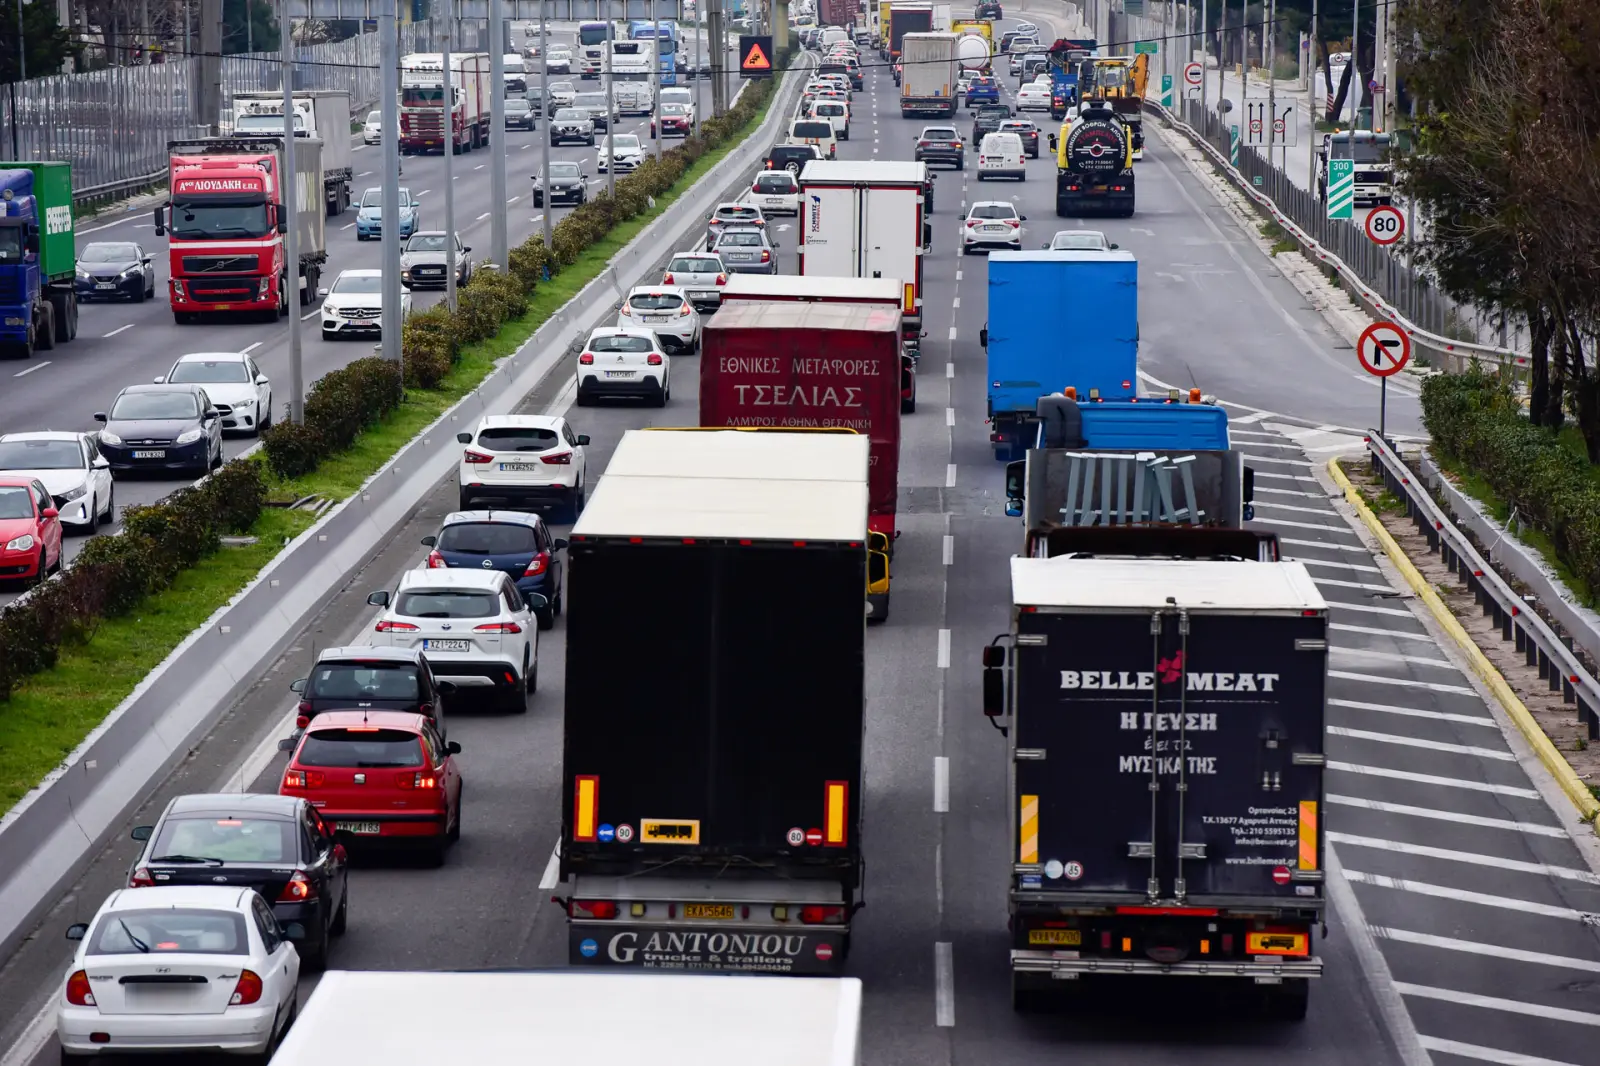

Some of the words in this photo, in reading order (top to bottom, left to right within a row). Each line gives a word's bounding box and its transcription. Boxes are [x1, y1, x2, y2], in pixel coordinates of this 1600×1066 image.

[1333, 162, 1349, 170] 300
[194, 180, 242, 191] ΛΙΟΥΔΑΚΗ
[1374, 217, 1396, 232] 80
[720, 357, 781, 374] ΕΘΝΙΚΕΣ
[792, 358, 880, 376] ΜΕΤΑΦΟΡΕΣ
[733, 385, 862, 407] ΤΣΕΛΙΑΣ
[726, 416, 777, 426] ΑΛΜΥΡΟΣ
[781, 417, 818, 427] ΑΘΗΝΑ
[822, 418, 872, 429] ΘΕΣ/ΝΙΚΗ
[1060, 670, 1155, 690] BELLE
[1186, 672, 1280, 692] MEAT
[1120, 711, 1138, 730] Η
[1143, 711, 1218, 731] ΓΕΥΣΗ
[1186, 756, 1217, 774] ΤΗΣ
[1287, 807, 1297, 815] 25
[619, 828, 630, 837] 90
[791, 832, 801, 841] 80
[1249, 827, 1263, 835] 210
[1264, 827, 1296, 835] 5595135
[1225, 856, 1297, 867] www.bellemeat.gr
[607, 931, 638, 963] G
[641, 931, 807, 956] ANTONIOU
[644, 952, 702, 962] trucks
[728, 955, 793, 964] trailers
